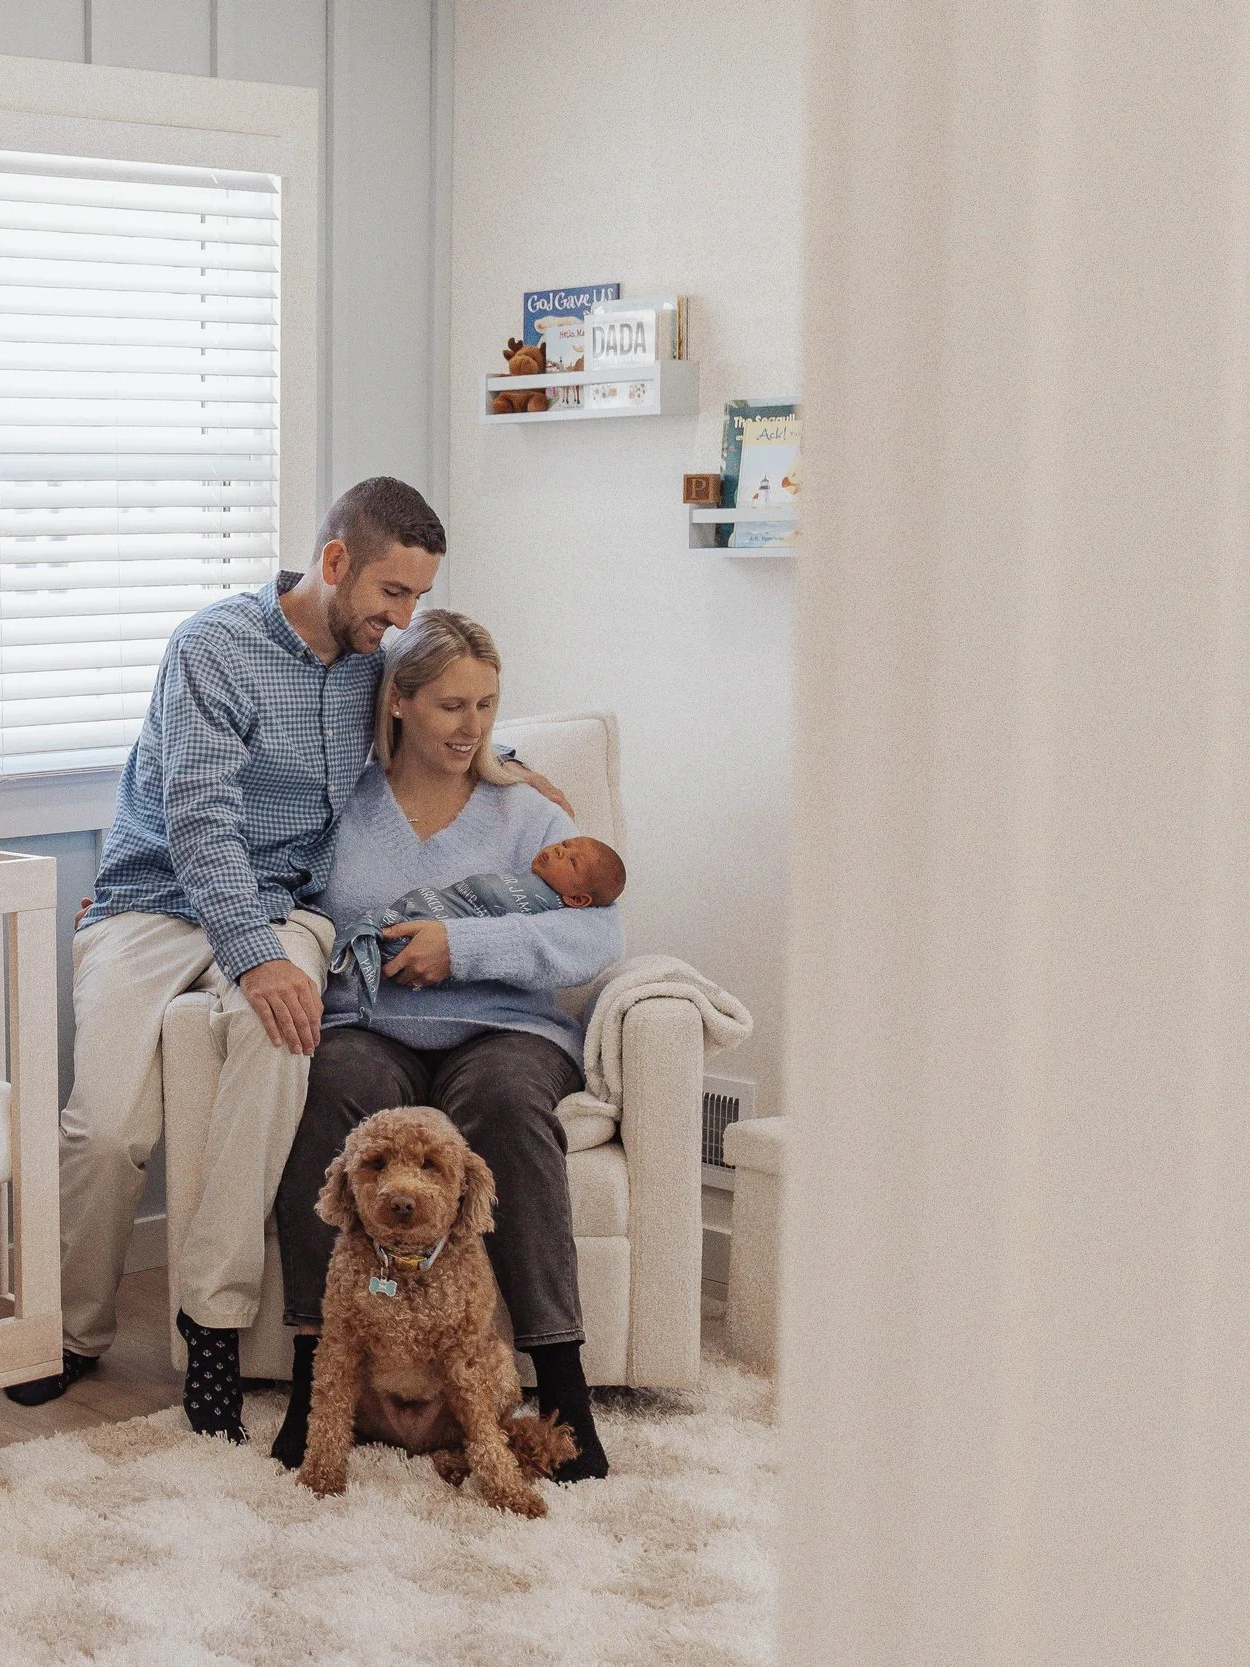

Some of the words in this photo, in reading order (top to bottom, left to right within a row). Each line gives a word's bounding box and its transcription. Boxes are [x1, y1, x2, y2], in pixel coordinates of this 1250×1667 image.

[527, 292, 553, 313] God
[554, 292, 592, 311] Gave
[592, 321, 647, 359] DADA
[756, 426, 787, 441] Ack!
[690, 479, 707, 500] P
[417, 887, 445, 913] ARKER
